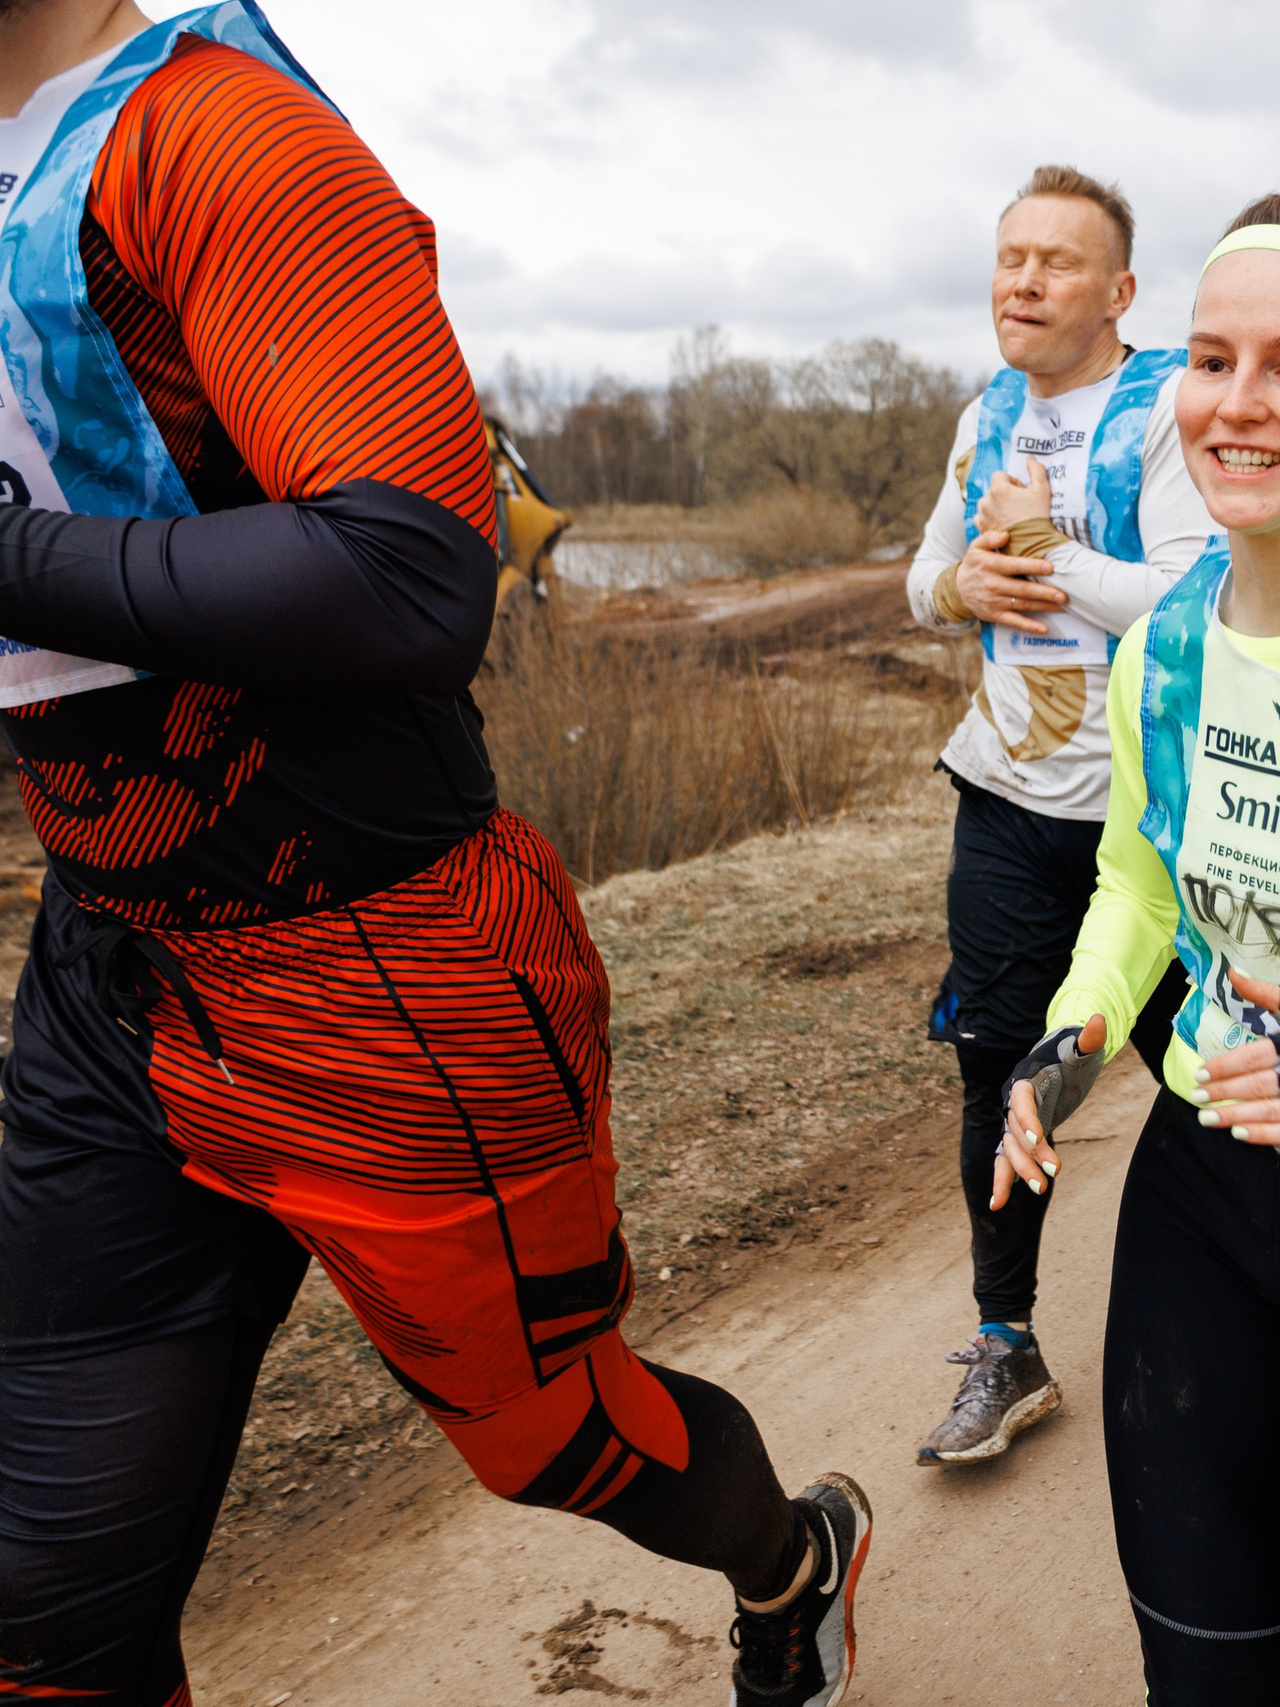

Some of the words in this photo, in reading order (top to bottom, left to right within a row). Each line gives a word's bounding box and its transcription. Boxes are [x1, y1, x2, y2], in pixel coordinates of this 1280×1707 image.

[1024, 637, 1079, 648] ГАЗПРОМБАНК
[1205, 724, 1277, 765] ГОНКА
[1206, 863, 1233, 881] FINE
